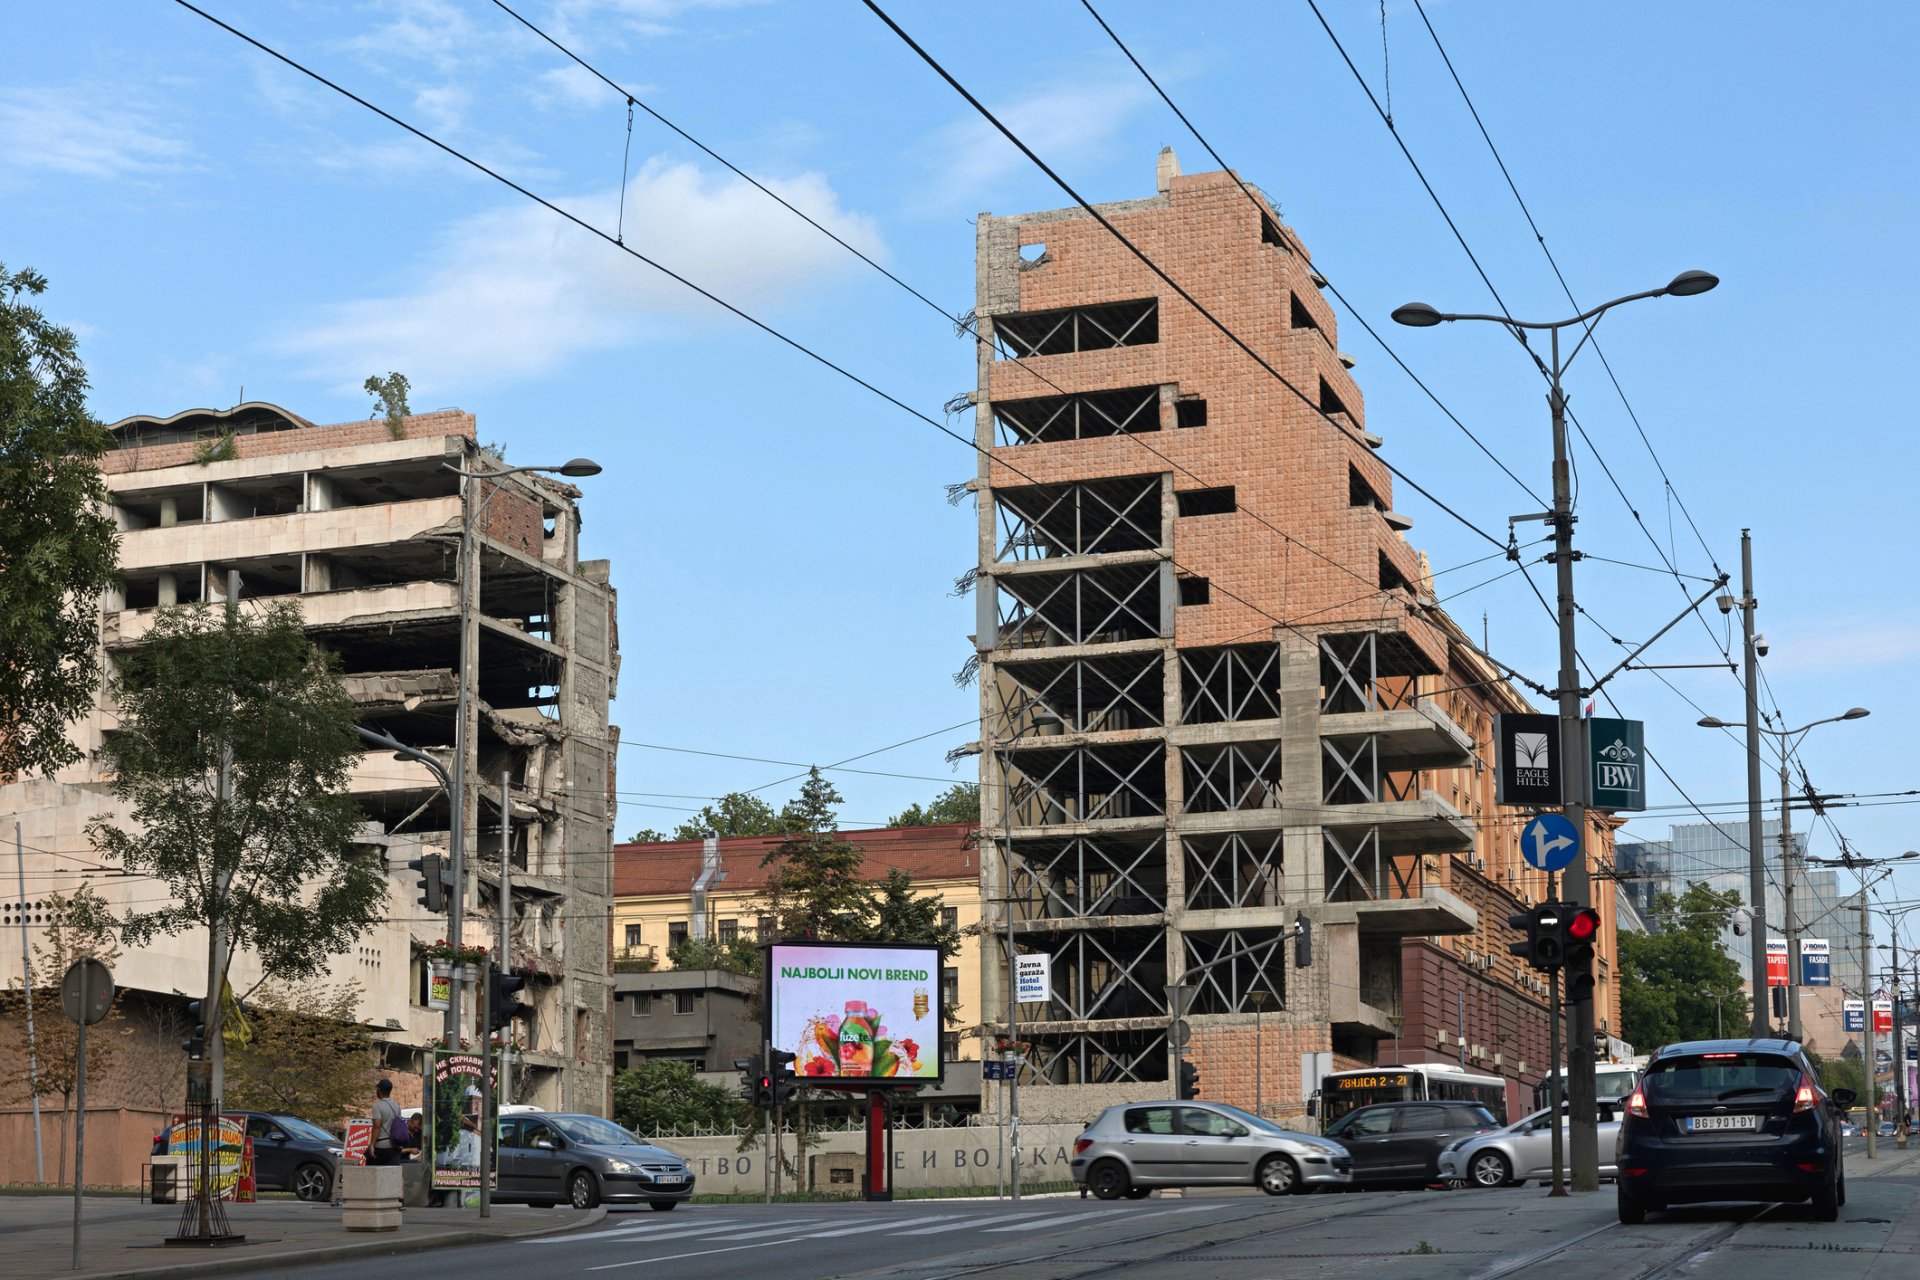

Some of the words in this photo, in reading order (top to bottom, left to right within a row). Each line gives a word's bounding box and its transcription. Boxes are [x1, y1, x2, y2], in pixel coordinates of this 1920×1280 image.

[1516, 769, 1549, 778] EAGLE
[1602, 765, 1636, 789] BW
[1516, 778, 1549, 787] HILLS
[1019, 961, 1042, 969] Javna
[1766, 956, 1787, 965] TAPETE
[1809, 956, 1829, 964] FASADE
[781, 966, 844, 980] NAJBOLJI
[847, 968, 882, 981] NOVI
[885, 969, 929, 981] BREND
[1019, 977, 1040, 985] Hotel
[436, 1060, 447, 1070] НЕ
[449, 1055, 489, 1068] СКРНАВИ
[436, 1070, 448, 1083] НЕ
[1380, 1076, 1386, 1087] 2
[922, 1150, 937, 1169] И
[954, 1147, 1070, 1169] ВОКА
